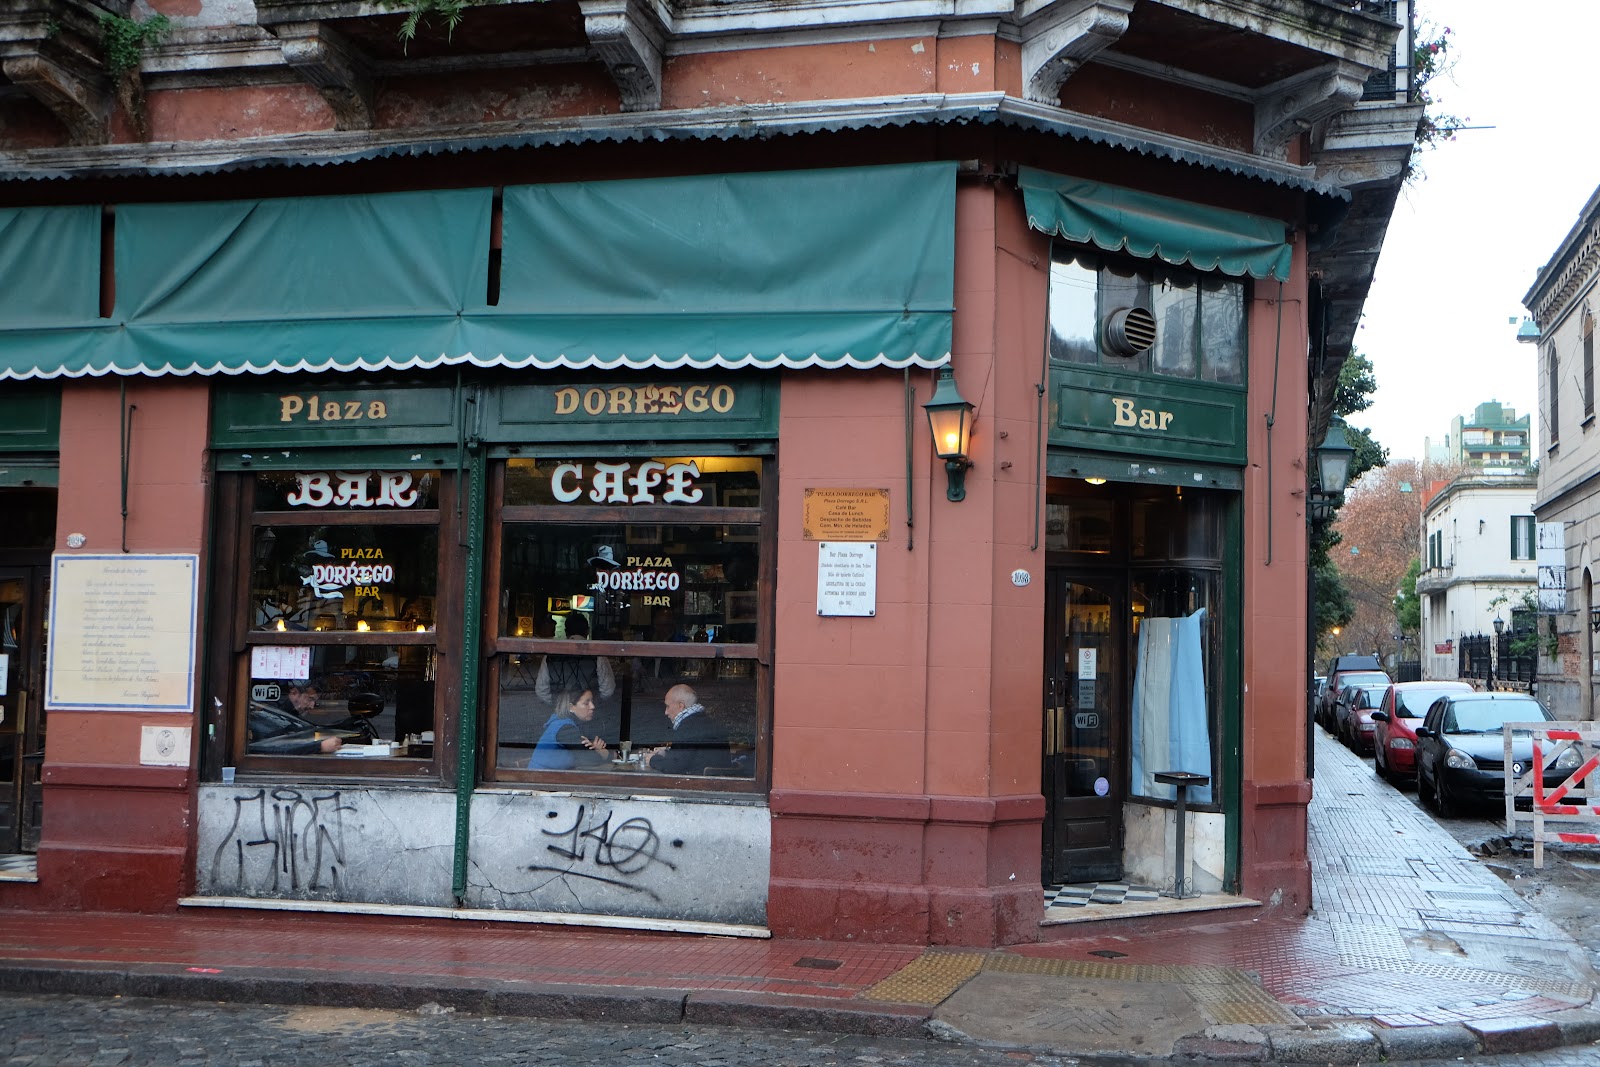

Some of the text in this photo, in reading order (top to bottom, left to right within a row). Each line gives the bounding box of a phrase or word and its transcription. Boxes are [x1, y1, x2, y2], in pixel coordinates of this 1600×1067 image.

[279, 384, 736, 422] Plaza DORREGO
[1111, 397, 1174, 431] Bar
[286, 471, 418, 508] BAR
[340, 548, 384, 559] PLAZA
[626, 556, 673, 567] PLAZA
[312, 561, 393, 587] DORREGO
[596, 568, 680, 591] DORREGO
[354, 586, 381, 601] BAR
[643, 595, 671, 607] BAR
